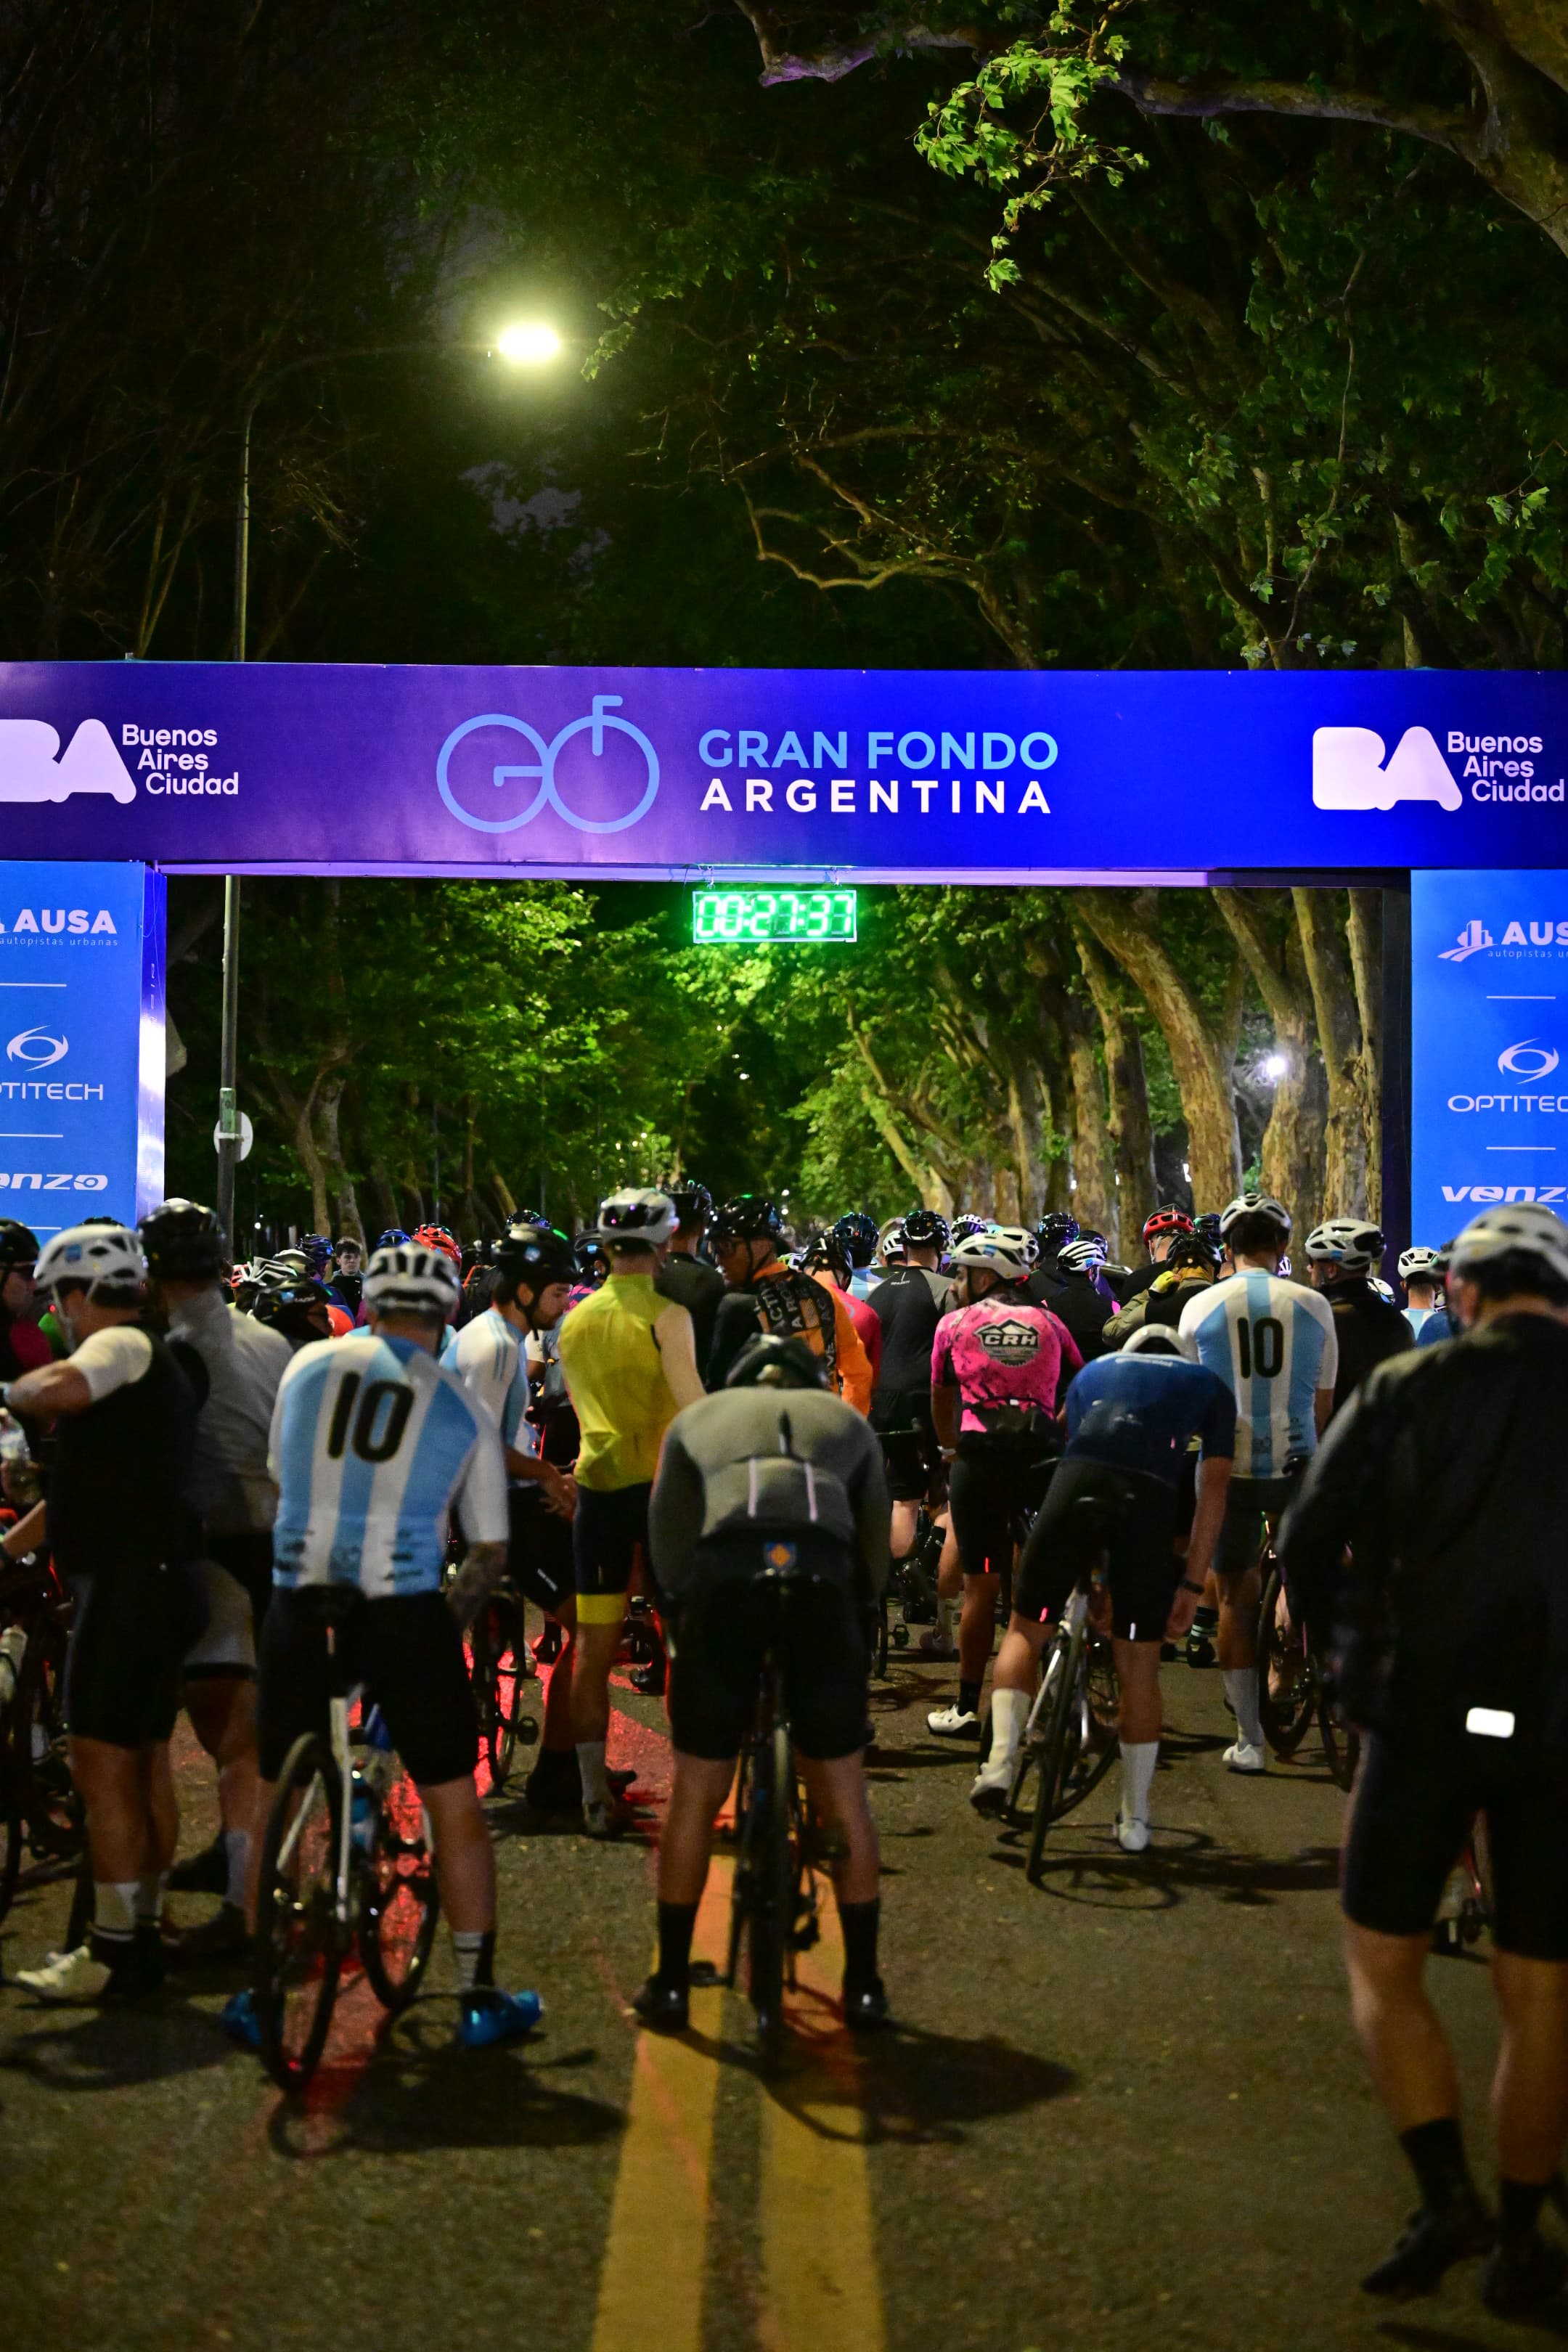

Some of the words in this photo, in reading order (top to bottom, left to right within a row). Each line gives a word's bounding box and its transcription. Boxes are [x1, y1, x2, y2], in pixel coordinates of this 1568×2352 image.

[122, 724, 218, 746] Buenos
[1447, 731, 1543, 754] Buenos
[137, 748, 209, 770] Aires
[698, 729, 848, 769] GRAN
[868, 731, 1058, 770] FONDO
[0, 719, 136, 804] BA
[1312, 726, 1463, 812] BA
[1463, 756, 1535, 777] Aires
[146, 772, 239, 795] Ciudad
[1471, 779, 1565, 802] Ciudad
[700, 778, 1051, 814] ARGENTINA
[13, 909, 118, 934] AUSA
[0, 936, 64, 947] autopistas
[70, 937, 118, 947] urbanas
[1487, 950, 1553, 960] autopistas
[0, 1082, 104, 1101] TITECH
[0, 1173, 109, 1191] nzo
[1441, 1185, 1568, 1202] venz
[984, 1334, 1037, 1345] CRH
[1237, 1317, 1284, 1379] 10
[328, 1371, 415, 1463] 10
